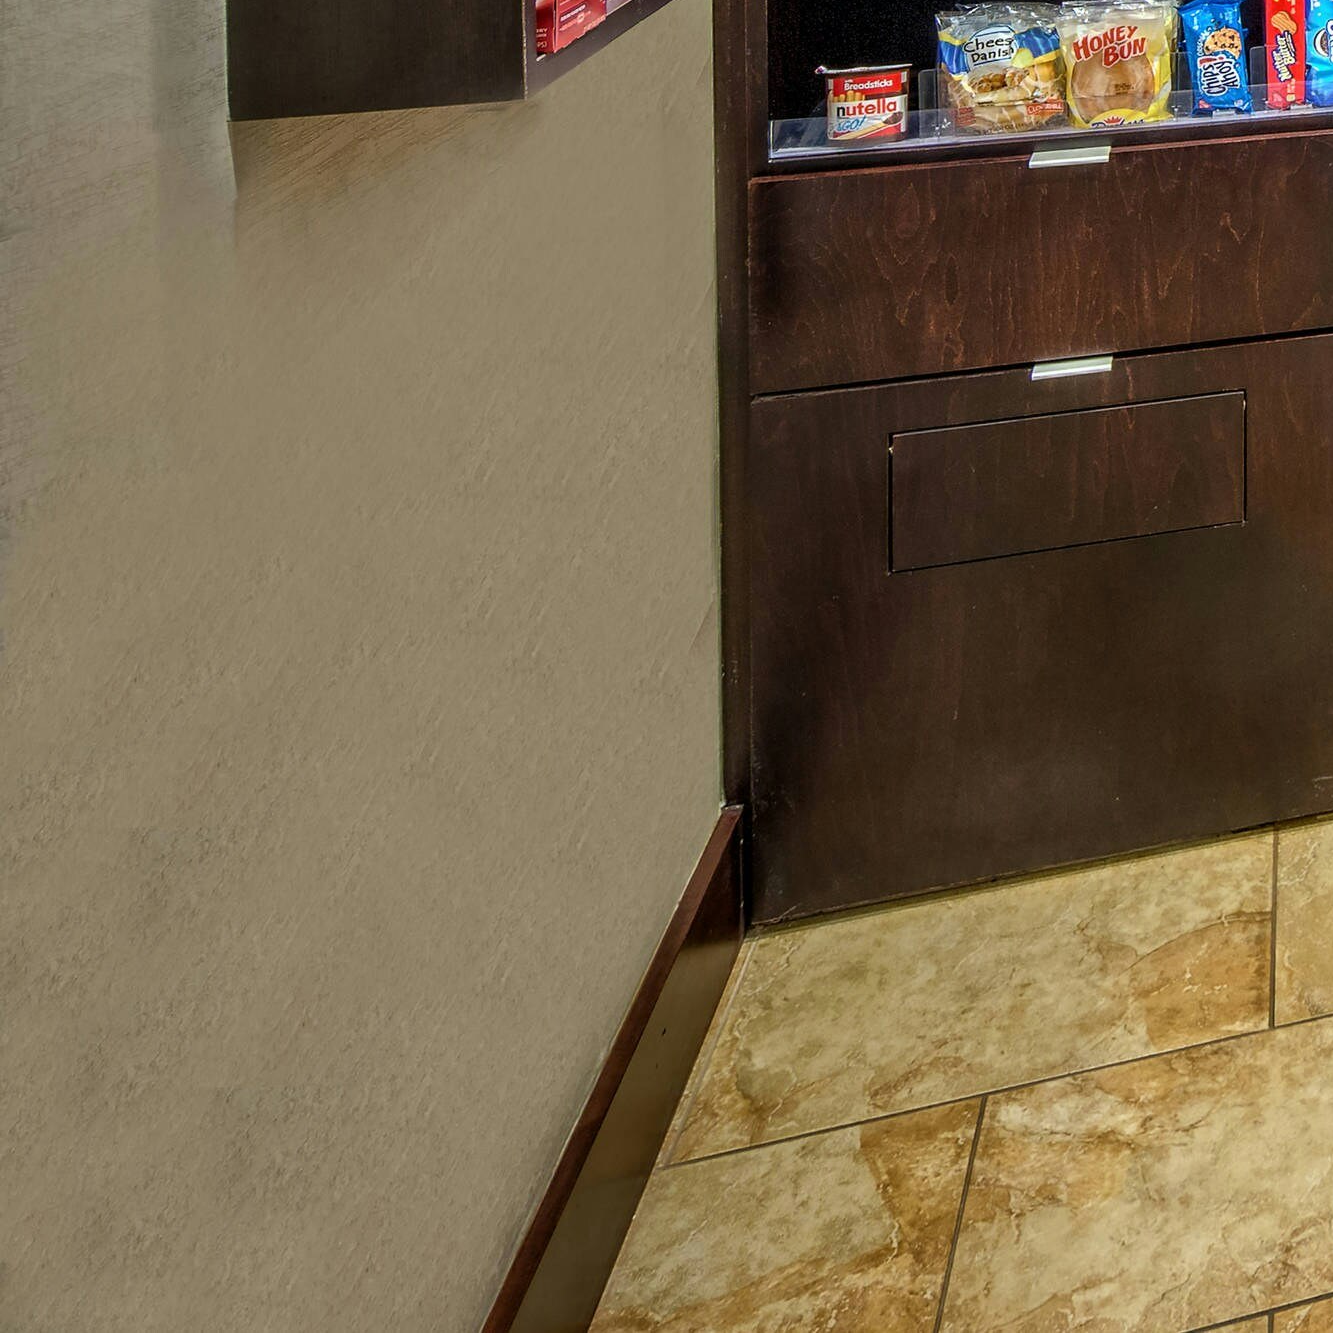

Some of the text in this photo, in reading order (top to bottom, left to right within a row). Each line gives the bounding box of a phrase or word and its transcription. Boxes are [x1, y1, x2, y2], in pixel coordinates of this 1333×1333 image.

[1073, 26, 1138, 62] HONEY
[1103, 37, 1146, 68] BUN
[837, 98, 897, 117] nutella
